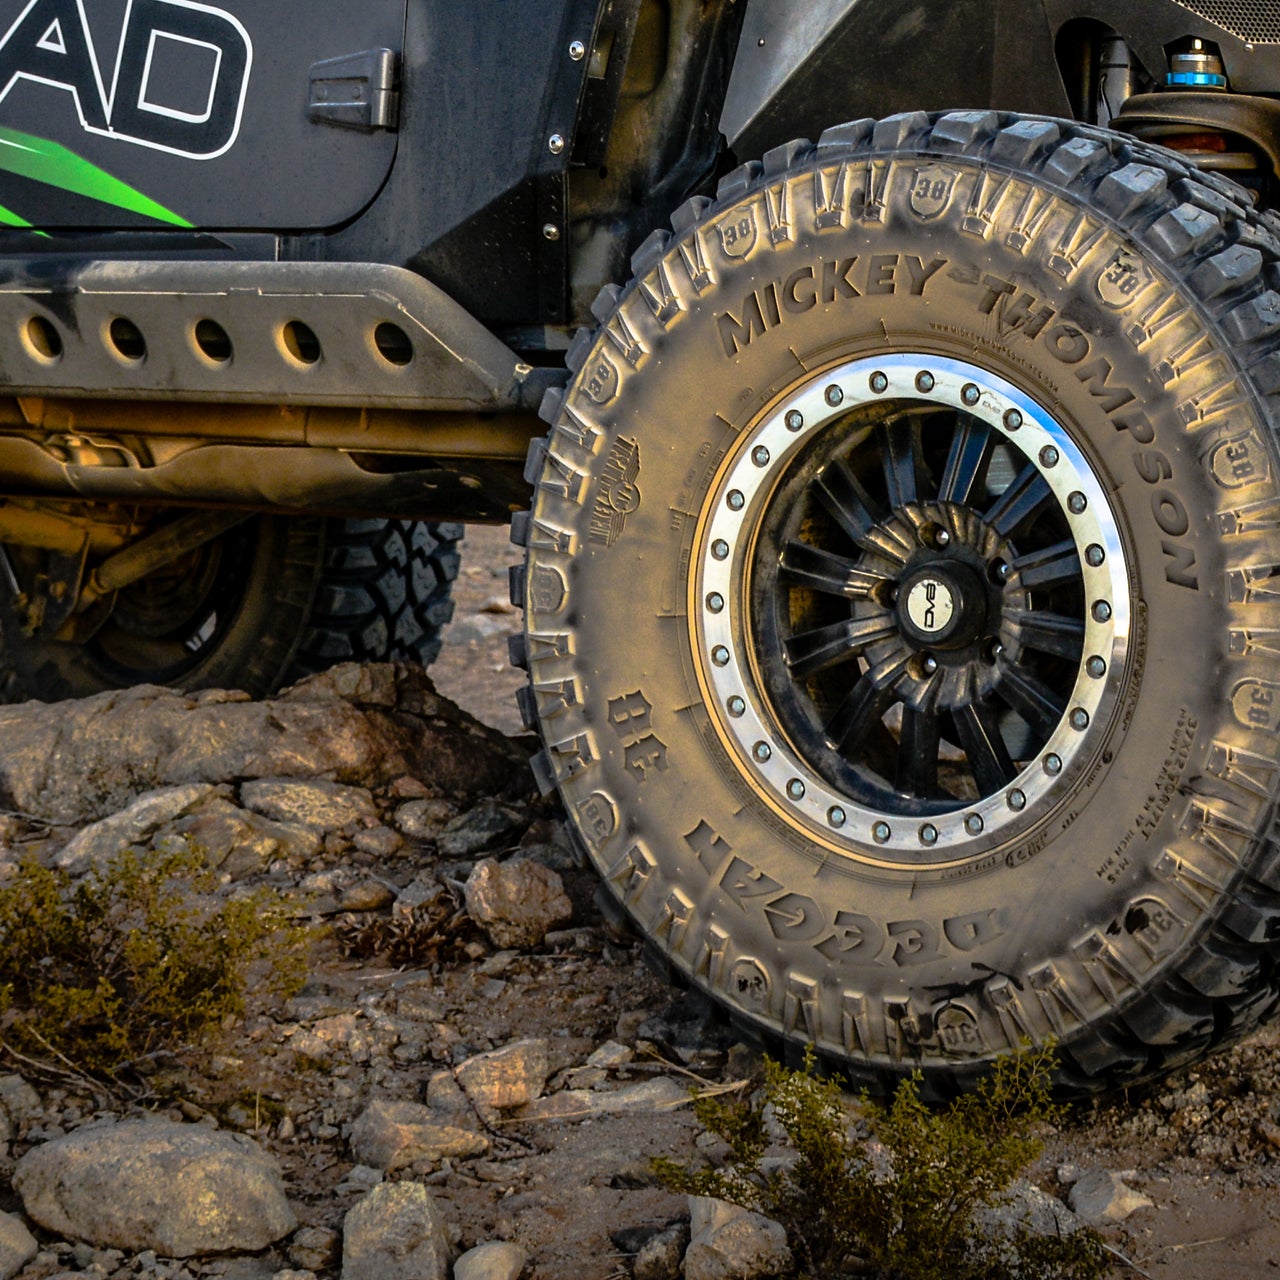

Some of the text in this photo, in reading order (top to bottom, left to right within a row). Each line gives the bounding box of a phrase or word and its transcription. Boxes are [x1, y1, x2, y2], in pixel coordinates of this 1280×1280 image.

[916, 177, 947, 201] 38
[723, 216, 752, 245] 38
[588, 364, 611, 394] 38
[717, 253, 1200, 592] MICKEY THOMPSON
[1227, 442, 1253, 480] 38
[924, 583, 936, 628] DV8
[1247, 687, 1274, 725] 38
[608, 689, 669, 784] 38
